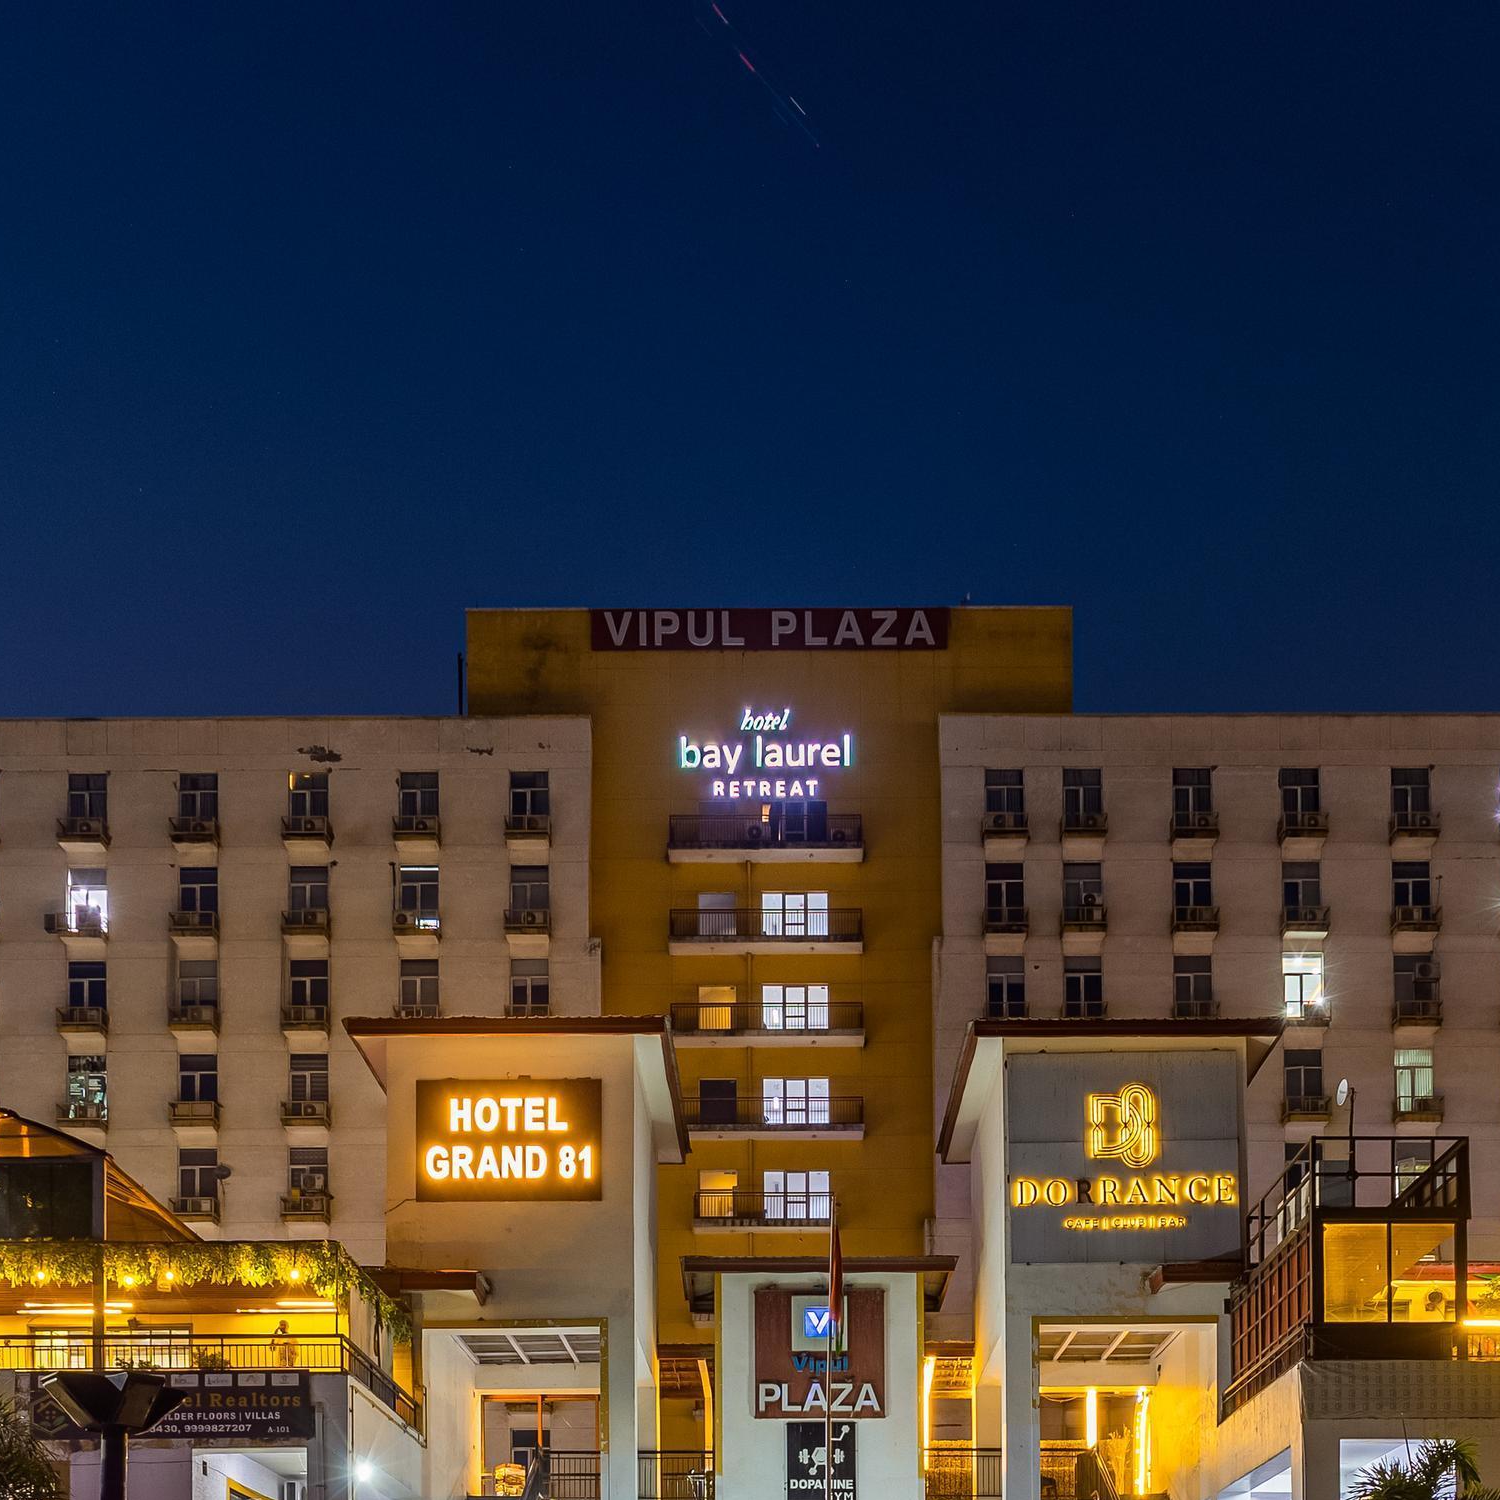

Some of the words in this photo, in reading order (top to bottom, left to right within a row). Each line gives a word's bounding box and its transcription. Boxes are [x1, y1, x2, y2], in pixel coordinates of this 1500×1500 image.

[603, 610, 746, 647] VIPUL
[771, 610, 936, 647] PLAZA
[740, 708, 790, 731] hotel
[680, 735, 743, 775] bay
[756, 733, 851, 768] laurel
[713, 780, 818, 797] RETREAT
[449, 1096, 569, 1132] HOTEL
[425, 1145, 548, 1180] GRAND
[558, 1145, 593, 1179] 81
[1016, 1175, 1237, 1207] DORRANCE
[1113, 1217, 1145, 1229] CLUB
[791, 1355, 849, 1376] Vipul
[209, 1391, 301, 1408] Realtors
[758, 1382, 881, 1412] PLAZA
[163, 1412, 194, 1421] ILDER
[197, 1411, 237, 1421] FLOORS
[245, 1411, 281, 1420] VILLAS
